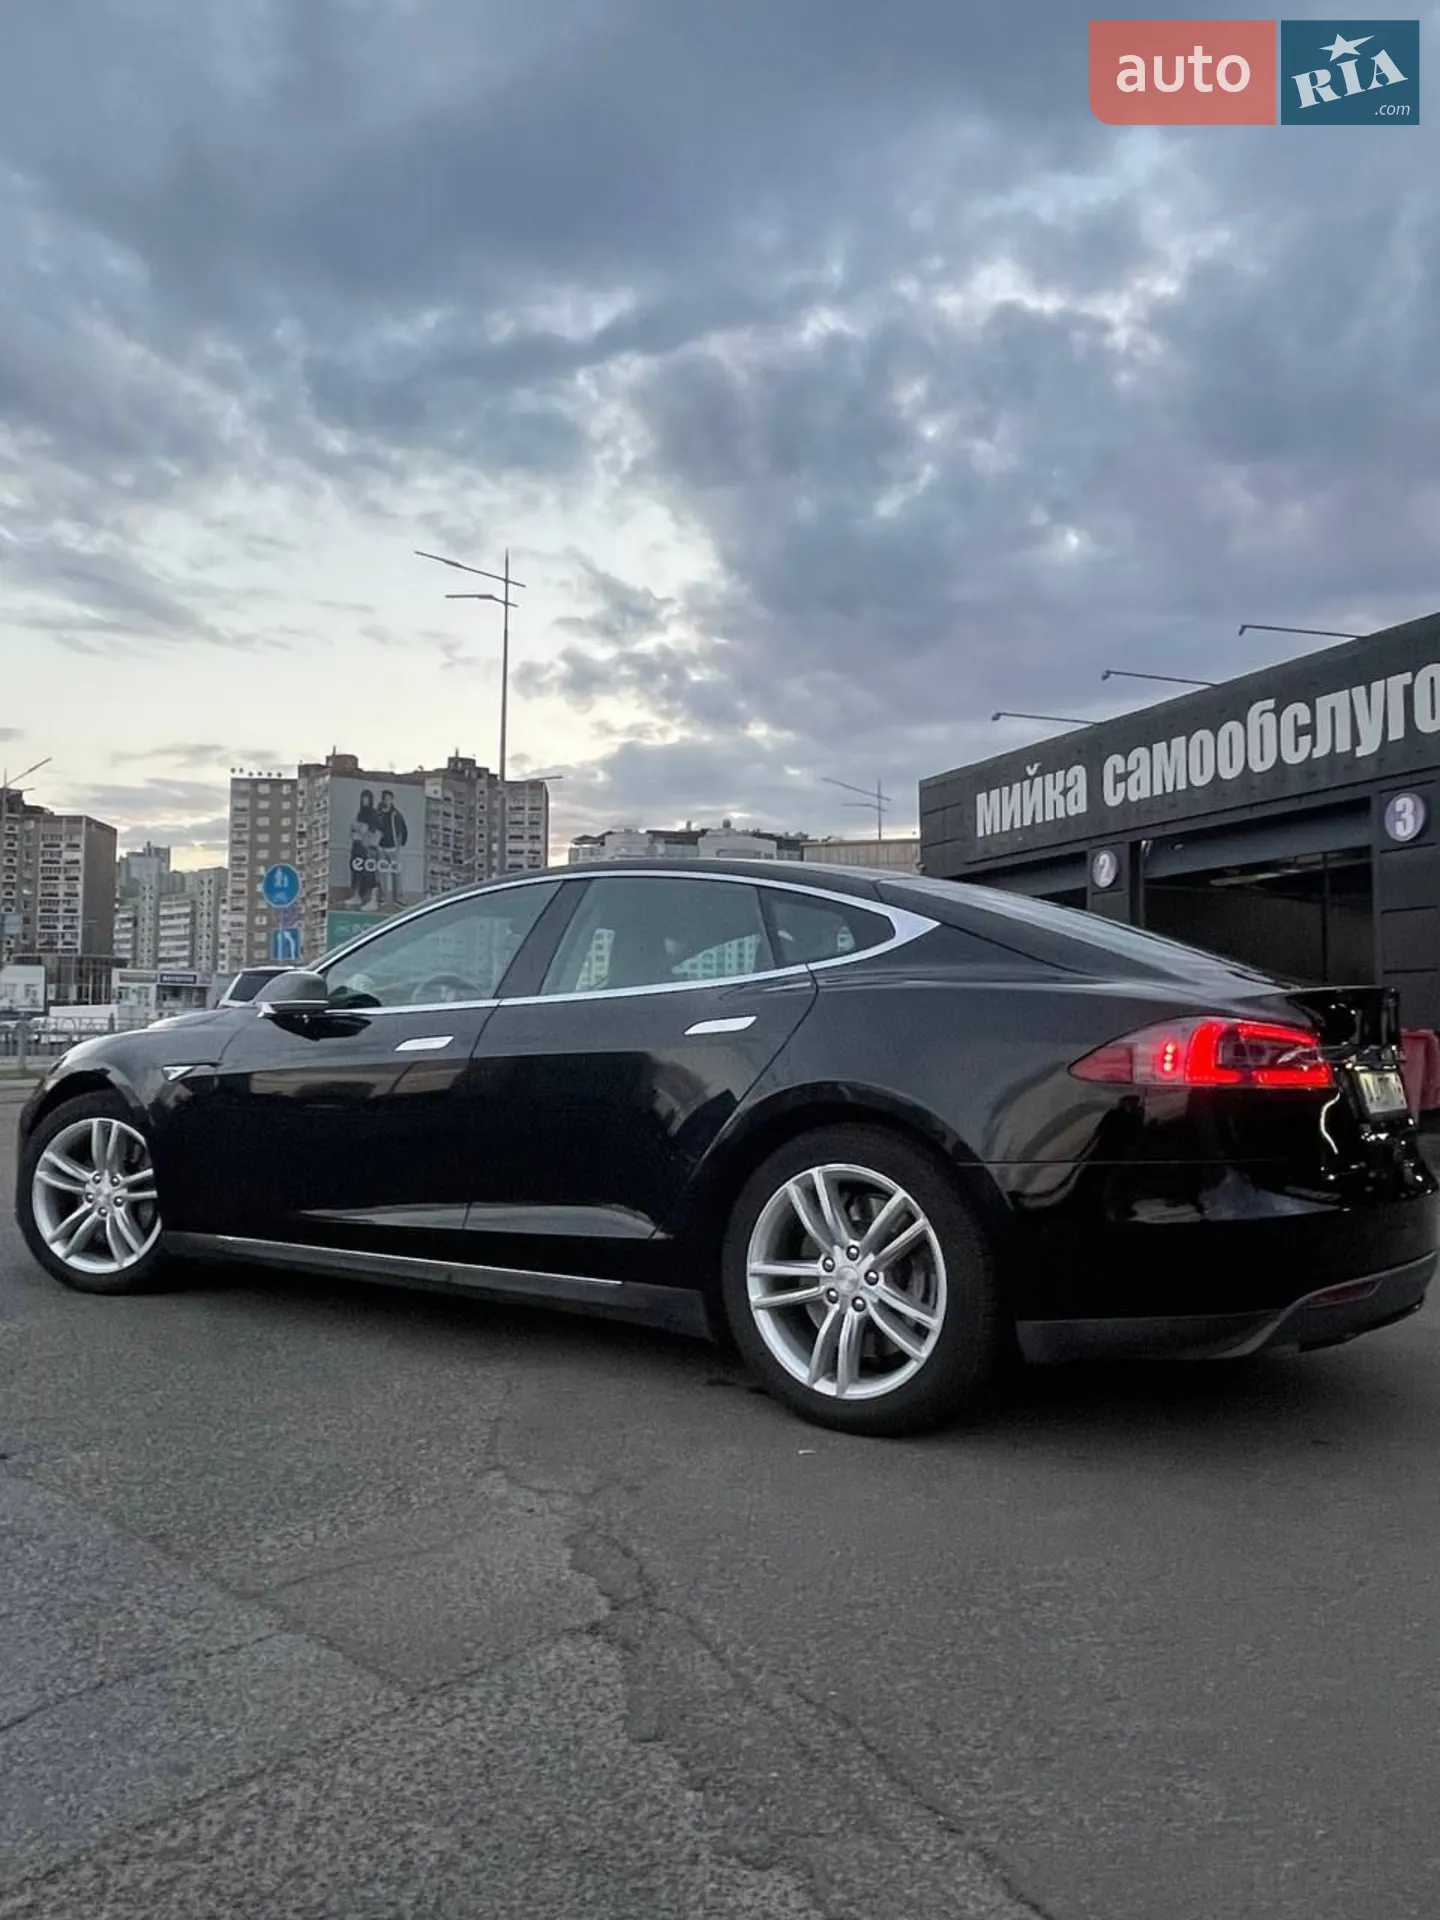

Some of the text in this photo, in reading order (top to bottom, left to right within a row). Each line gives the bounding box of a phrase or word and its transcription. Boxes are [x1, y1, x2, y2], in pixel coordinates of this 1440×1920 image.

[976, 663, 1440, 838] мийка самообслуго
[1395, 797, 1414, 837] 3
[1099, 853, 1112, 885] 2
